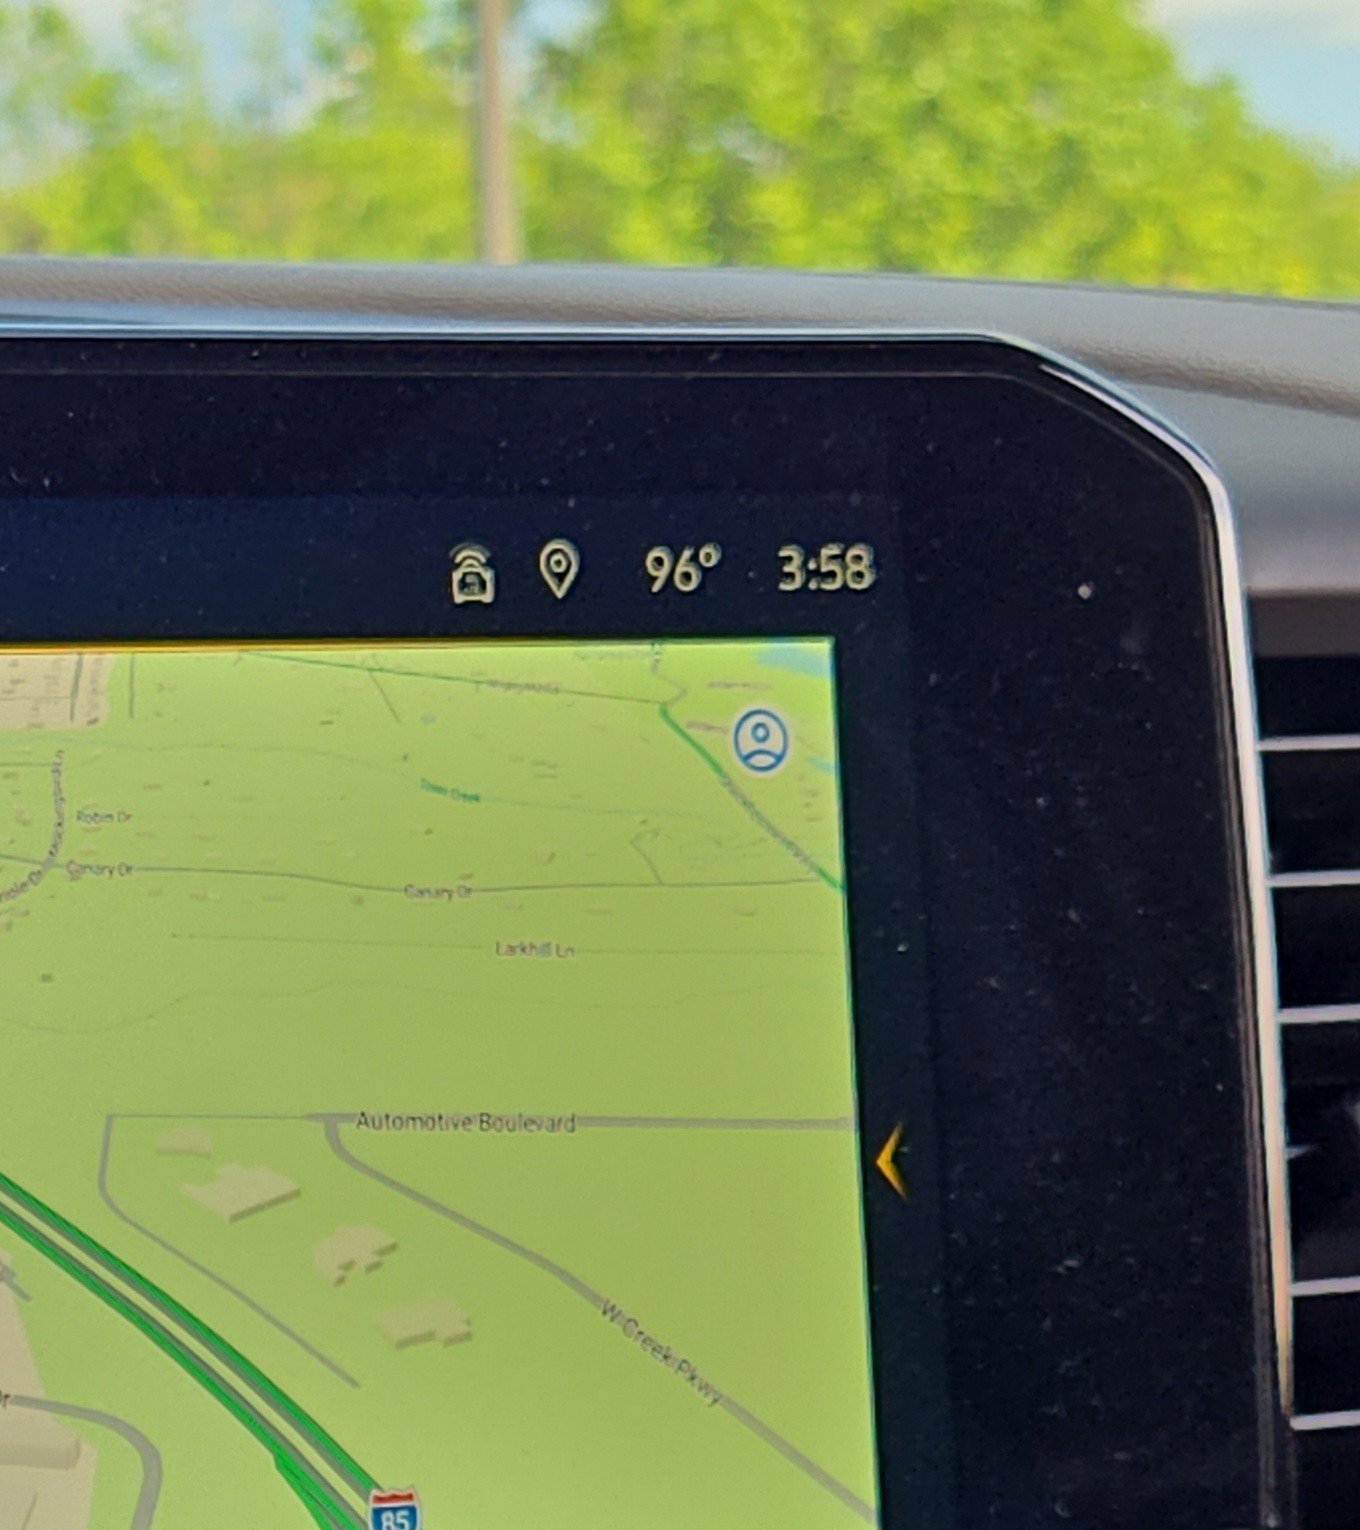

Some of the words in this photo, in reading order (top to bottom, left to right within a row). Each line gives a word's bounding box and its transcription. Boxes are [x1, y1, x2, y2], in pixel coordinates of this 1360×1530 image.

[645, 542, 722, 593] 96°
[778, 543, 877, 592] 3:58
[355, 1111, 474, 1132] Automotive
[479, 1112, 576, 1133] Boulevard
[601, 1299, 620, 1324] W
[621, 1317, 677, 1367] Creek
[675, 1358, 723, 1407] Pkwy
